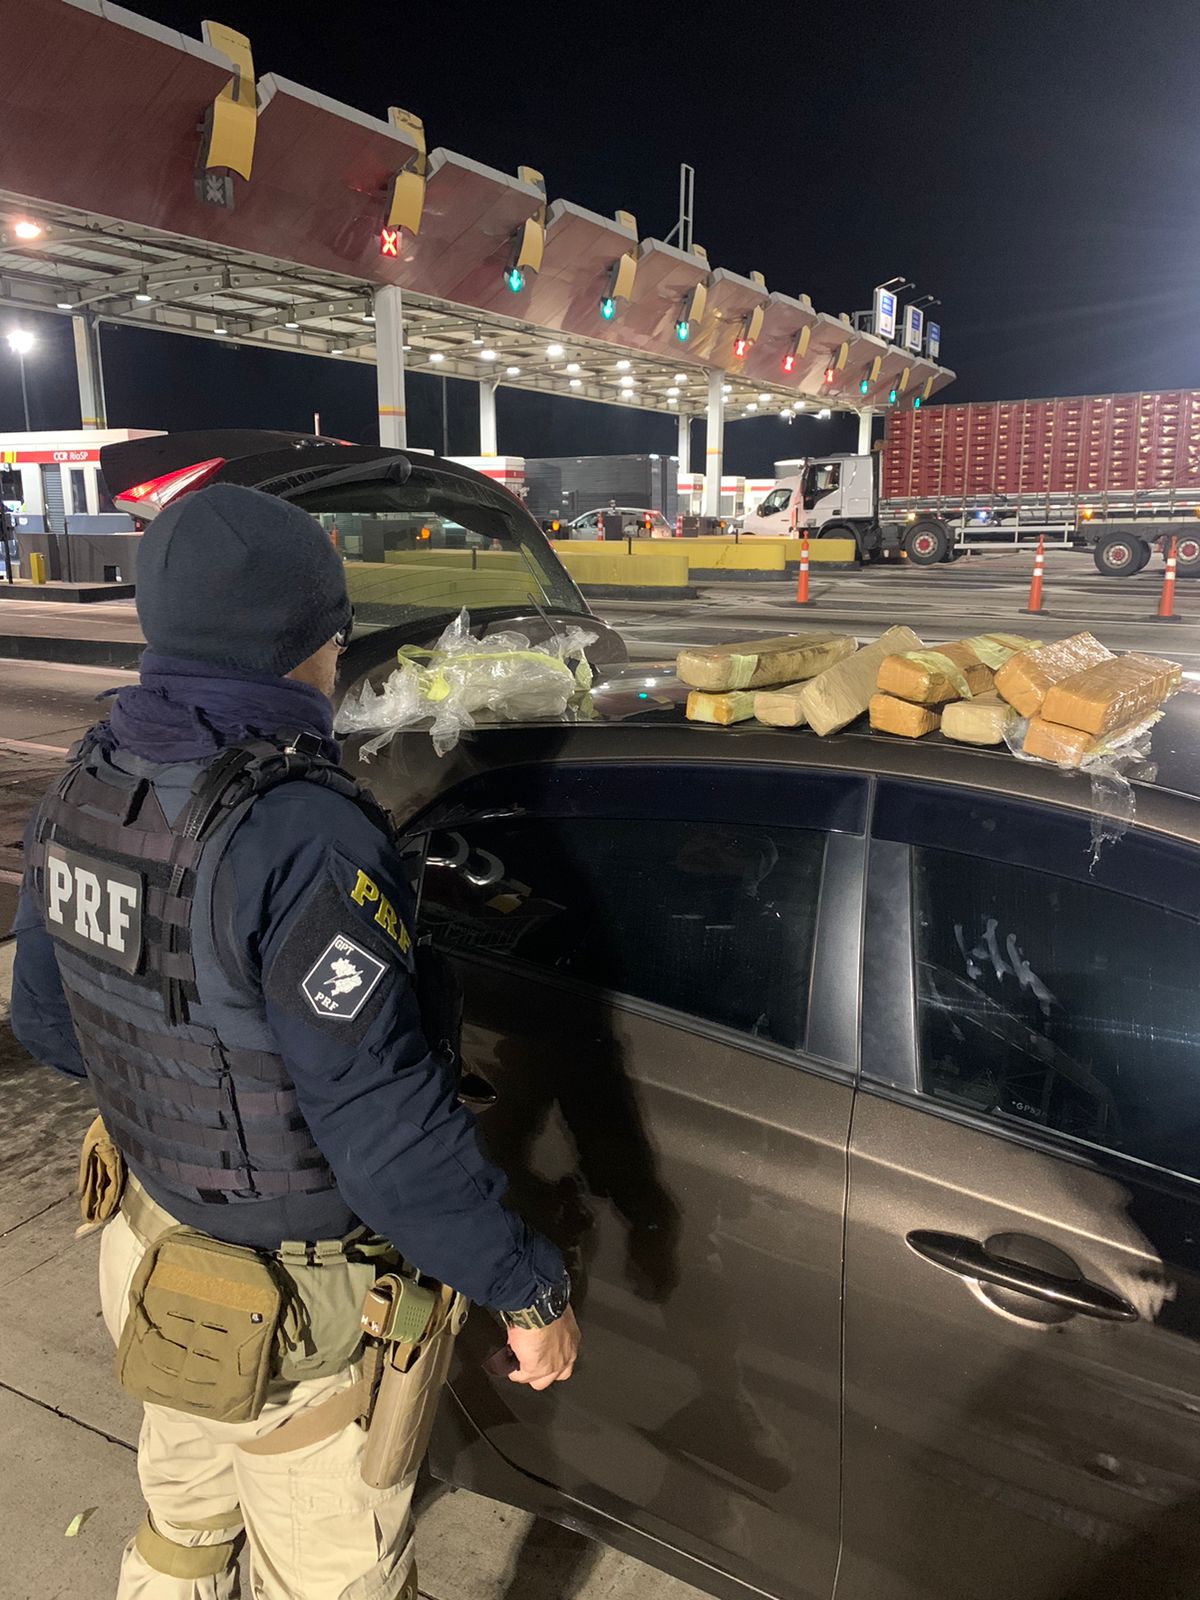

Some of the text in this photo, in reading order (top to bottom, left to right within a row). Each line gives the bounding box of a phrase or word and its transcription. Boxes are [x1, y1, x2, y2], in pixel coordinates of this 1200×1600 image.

[53, 451, 88, 461] CCR RioSP
[48, 855, 137, 953] PRF
[334, 939, 355, 957] GPT
[313, 991, 340, 1012] PRF
